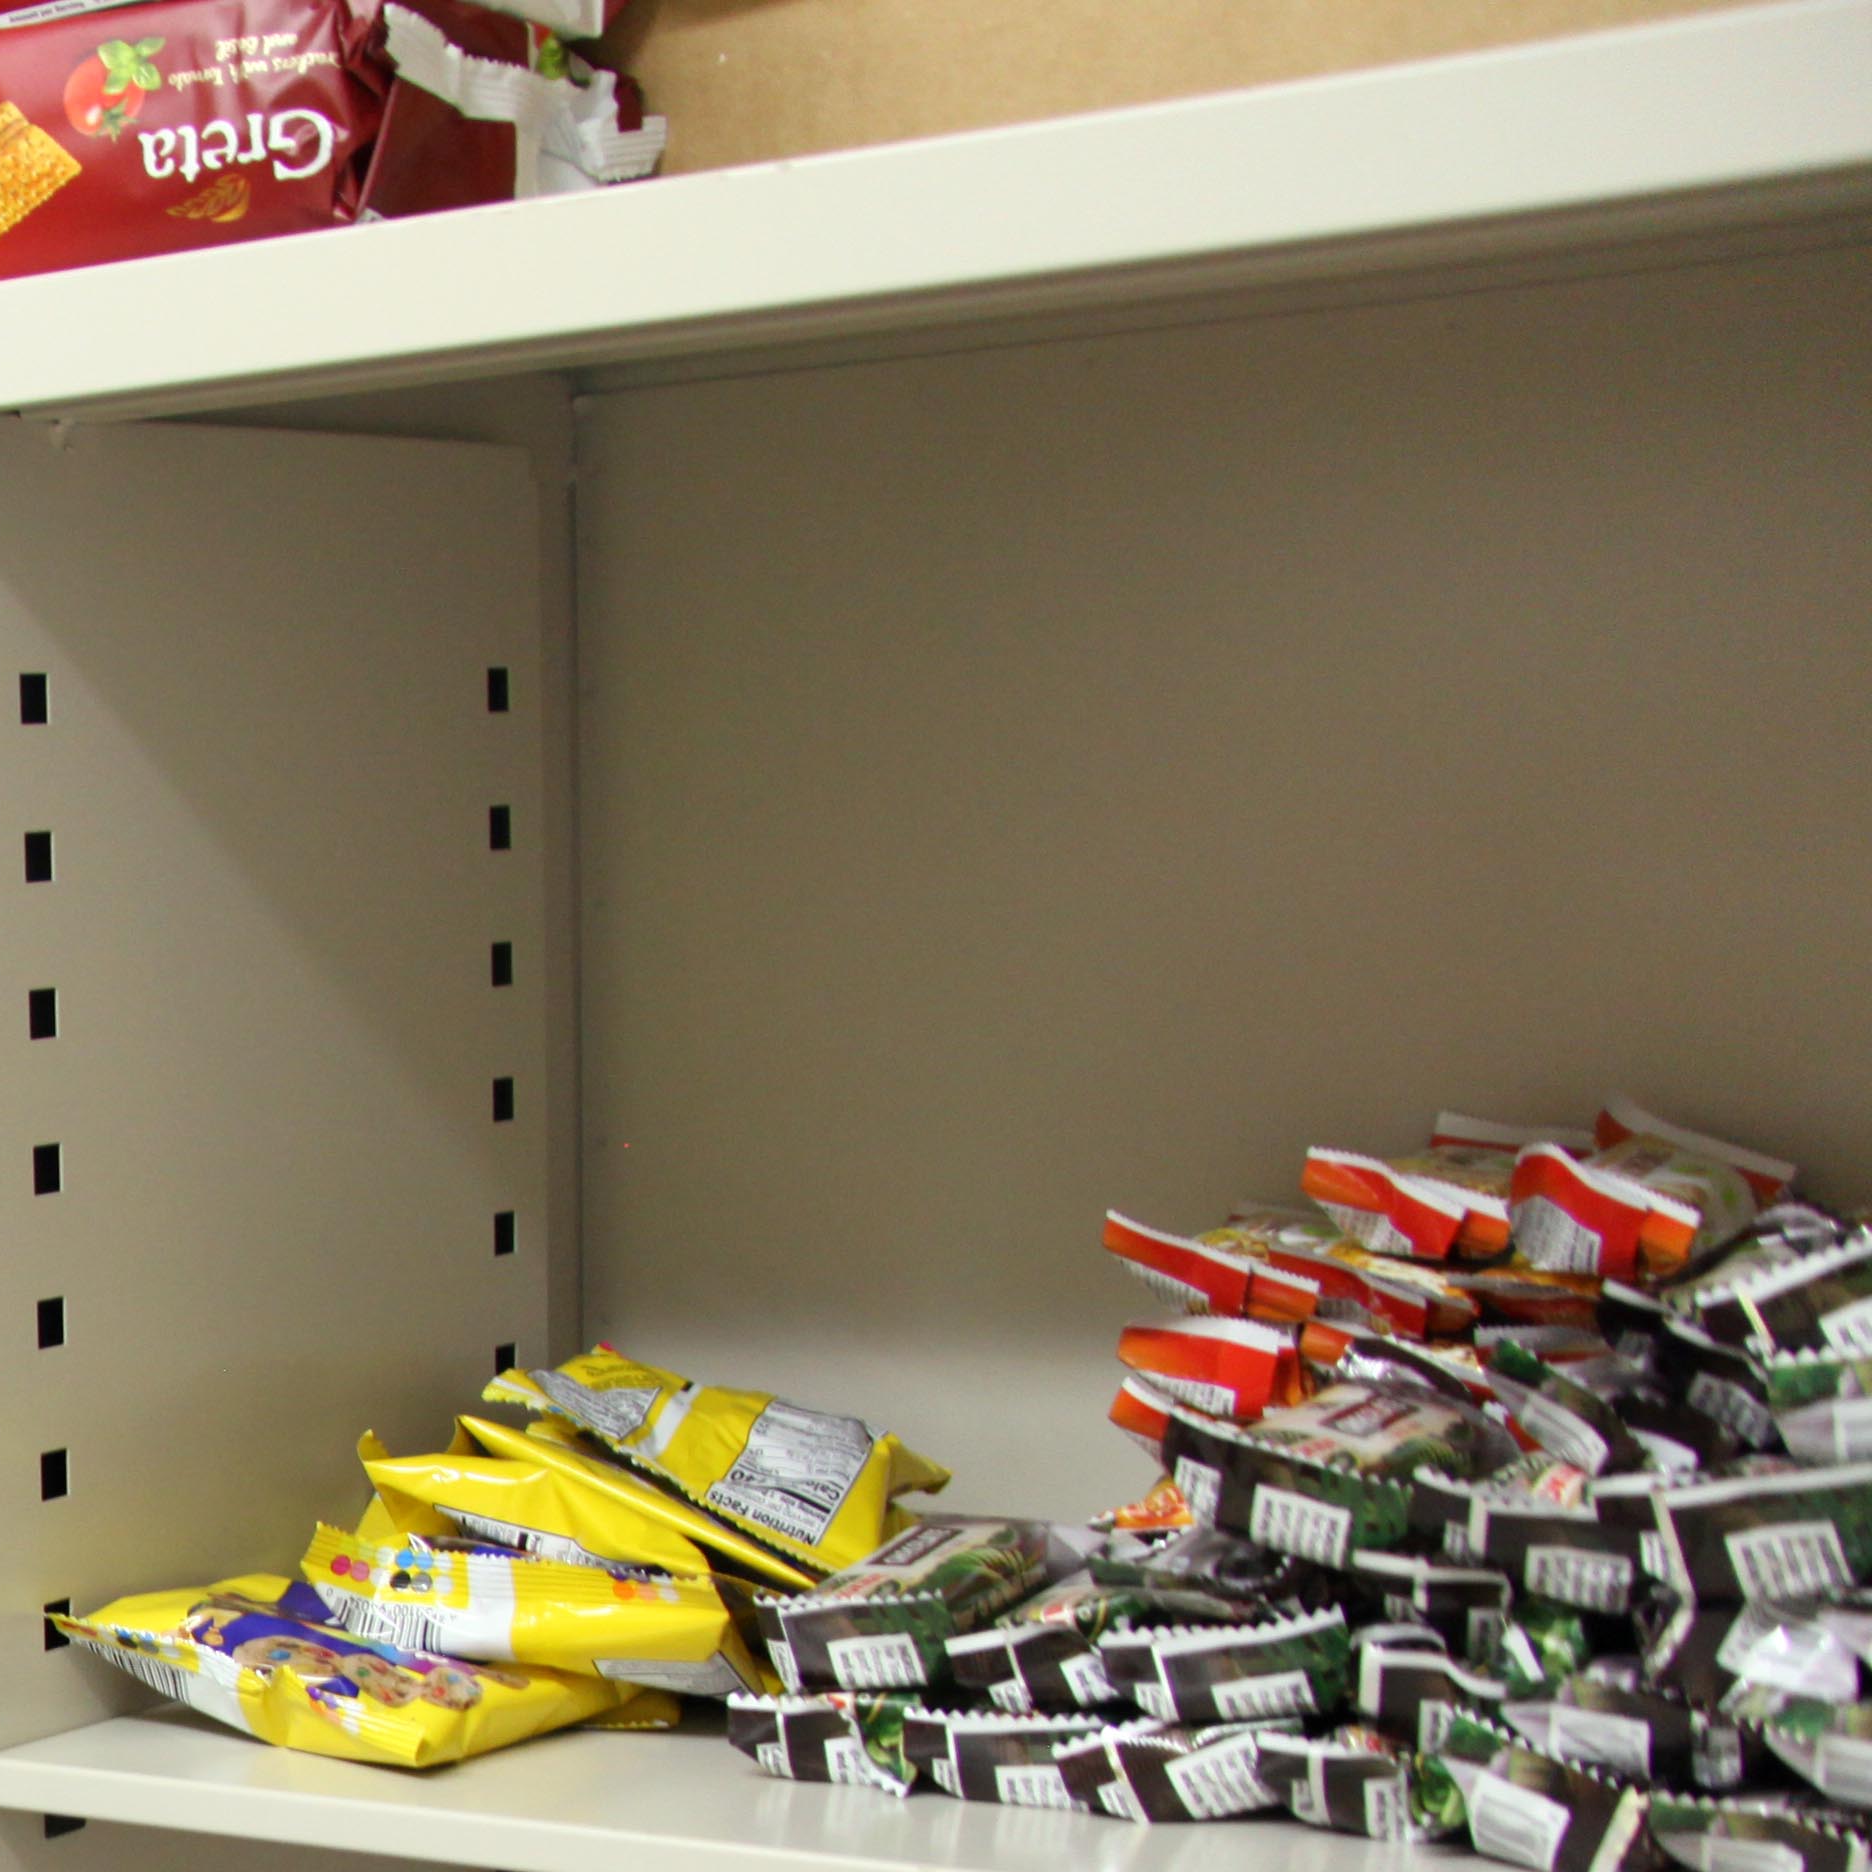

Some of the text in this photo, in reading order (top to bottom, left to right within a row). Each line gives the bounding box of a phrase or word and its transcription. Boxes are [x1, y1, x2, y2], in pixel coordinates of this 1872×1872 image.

[138, 108, 333, 182] Greta
[709, 1490, 817, 1547] Nutrition Facts
